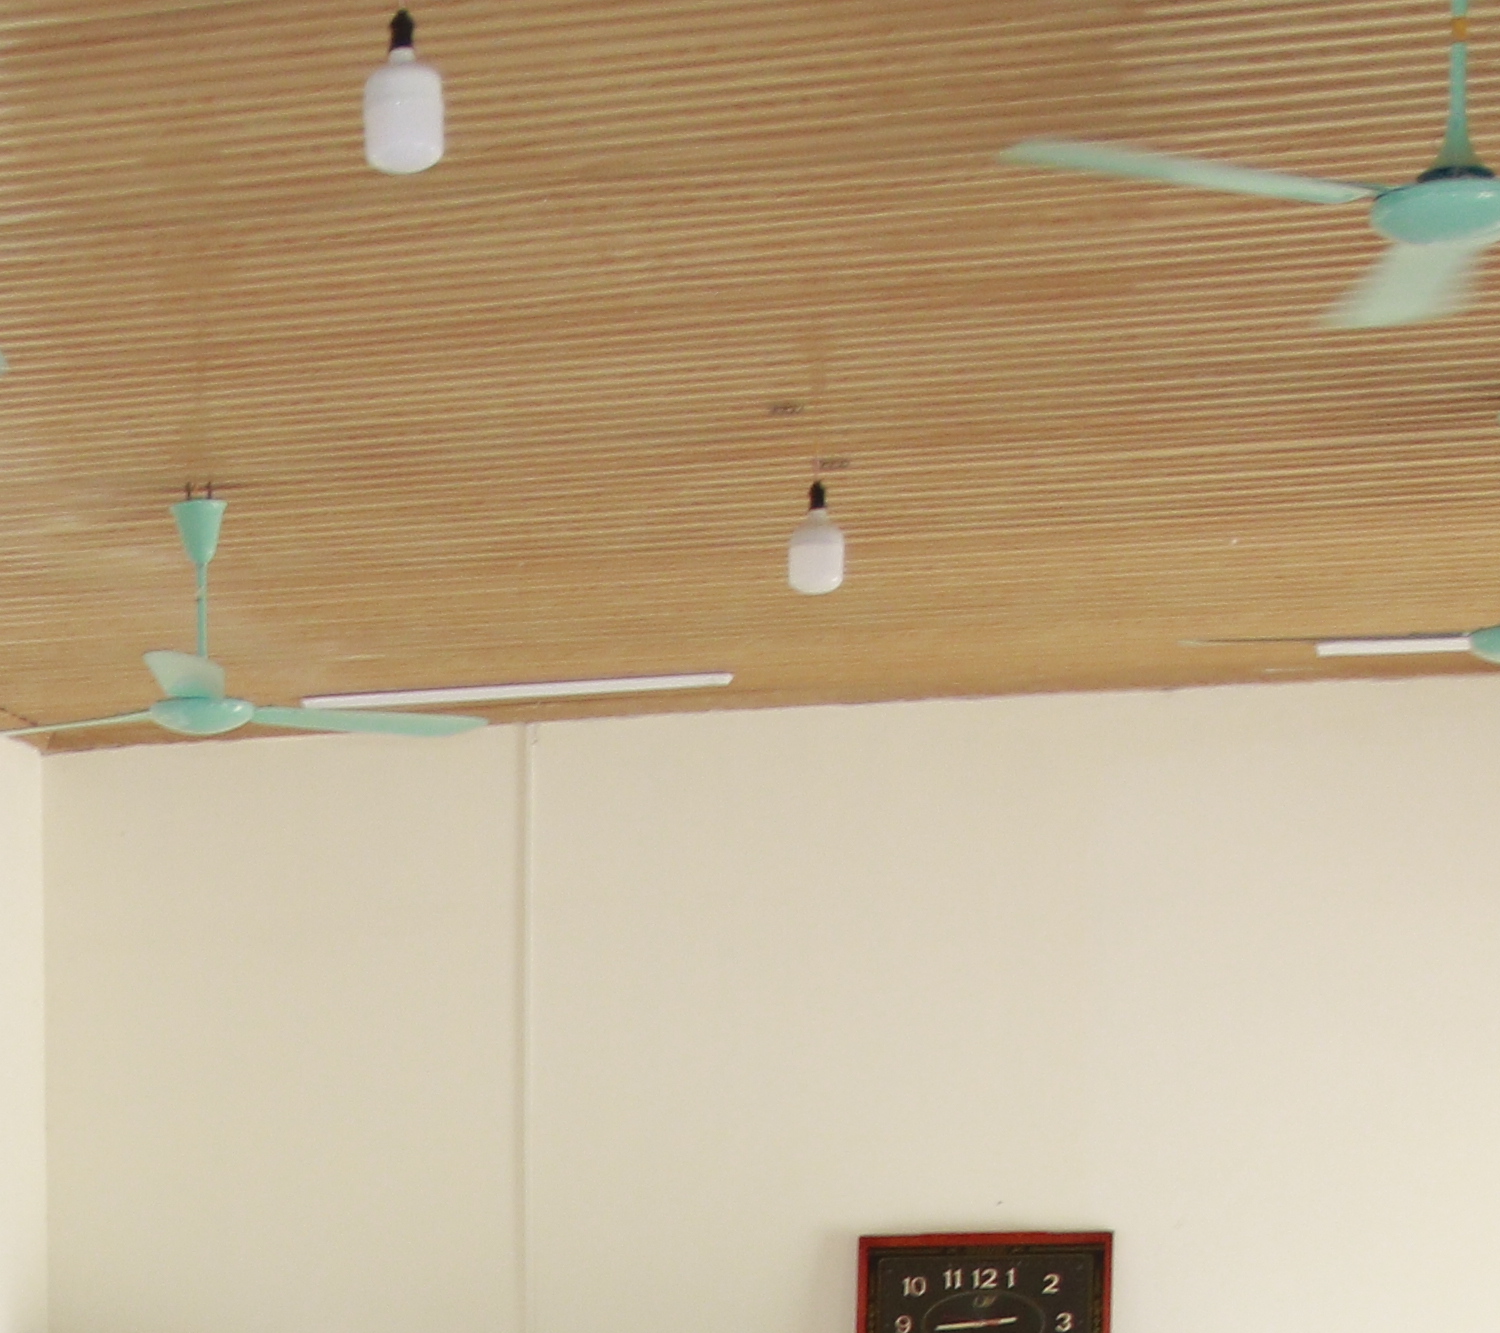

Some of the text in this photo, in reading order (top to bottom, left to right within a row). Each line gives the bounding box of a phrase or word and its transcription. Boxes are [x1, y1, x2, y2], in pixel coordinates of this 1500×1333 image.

[902, 1276, 926, 1297] 10
[943, 1267, 1016, 1290] 11 12 1
[1042, 1274, 1060, 1294] 2
[1055, 1312, 1073, 1333] 3
